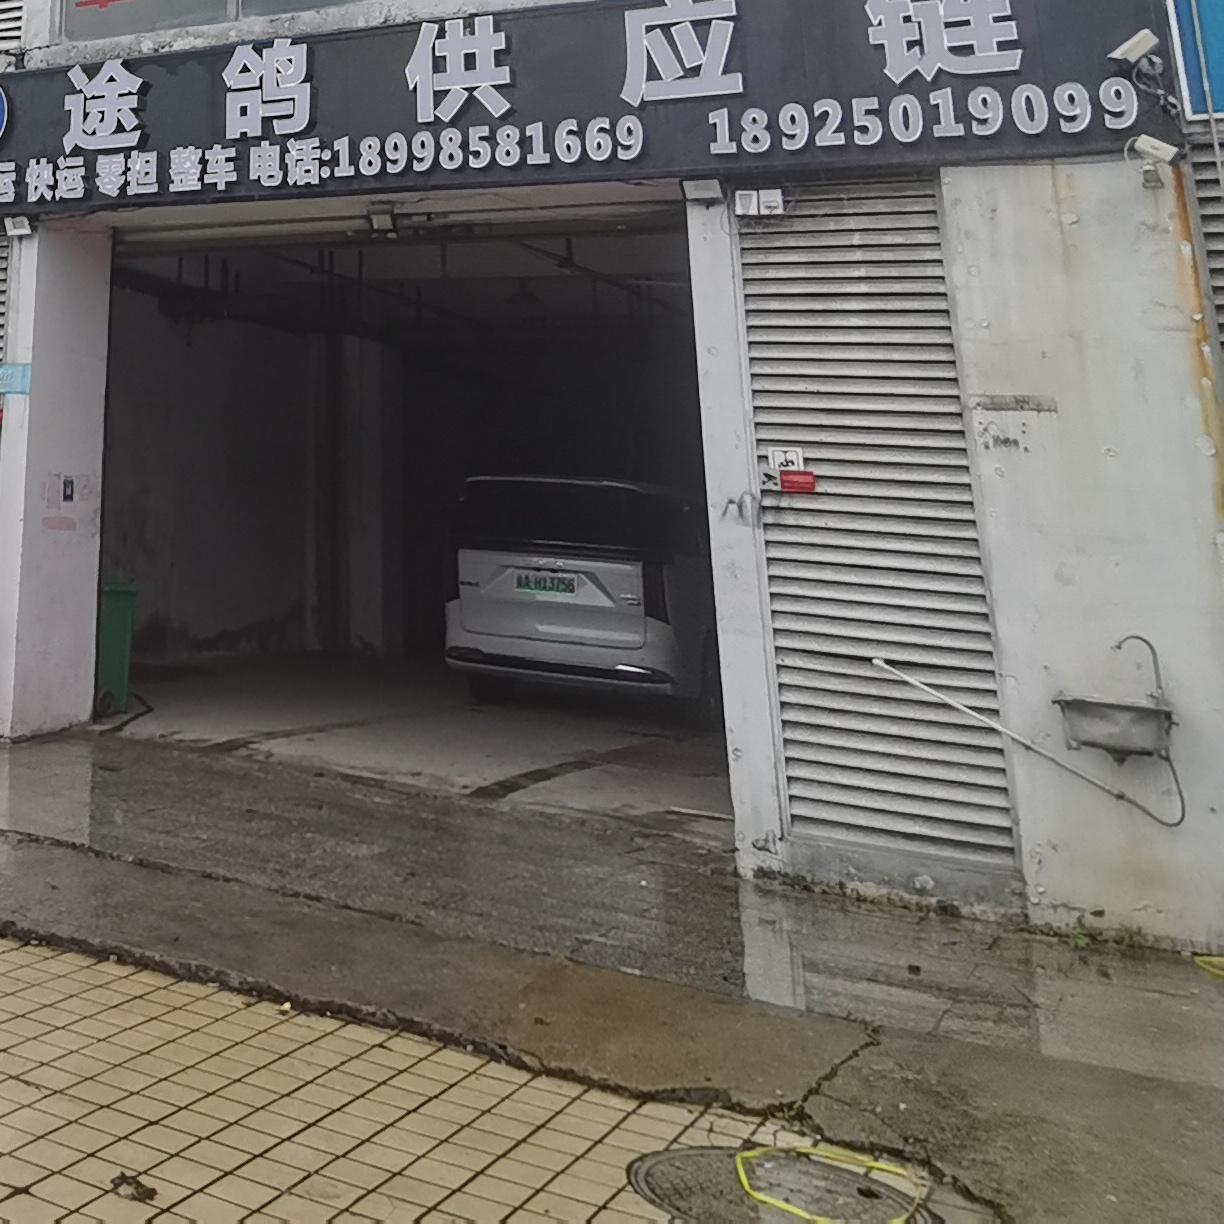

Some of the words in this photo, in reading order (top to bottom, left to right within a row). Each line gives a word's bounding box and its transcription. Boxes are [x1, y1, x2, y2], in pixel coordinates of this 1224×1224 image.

[26, 155, 85, 202] 快运
[95, 150, 158, 198] 零担
[169, 144, 237, 192] 整车
[708, 76, 1139, 154] 18925019099
